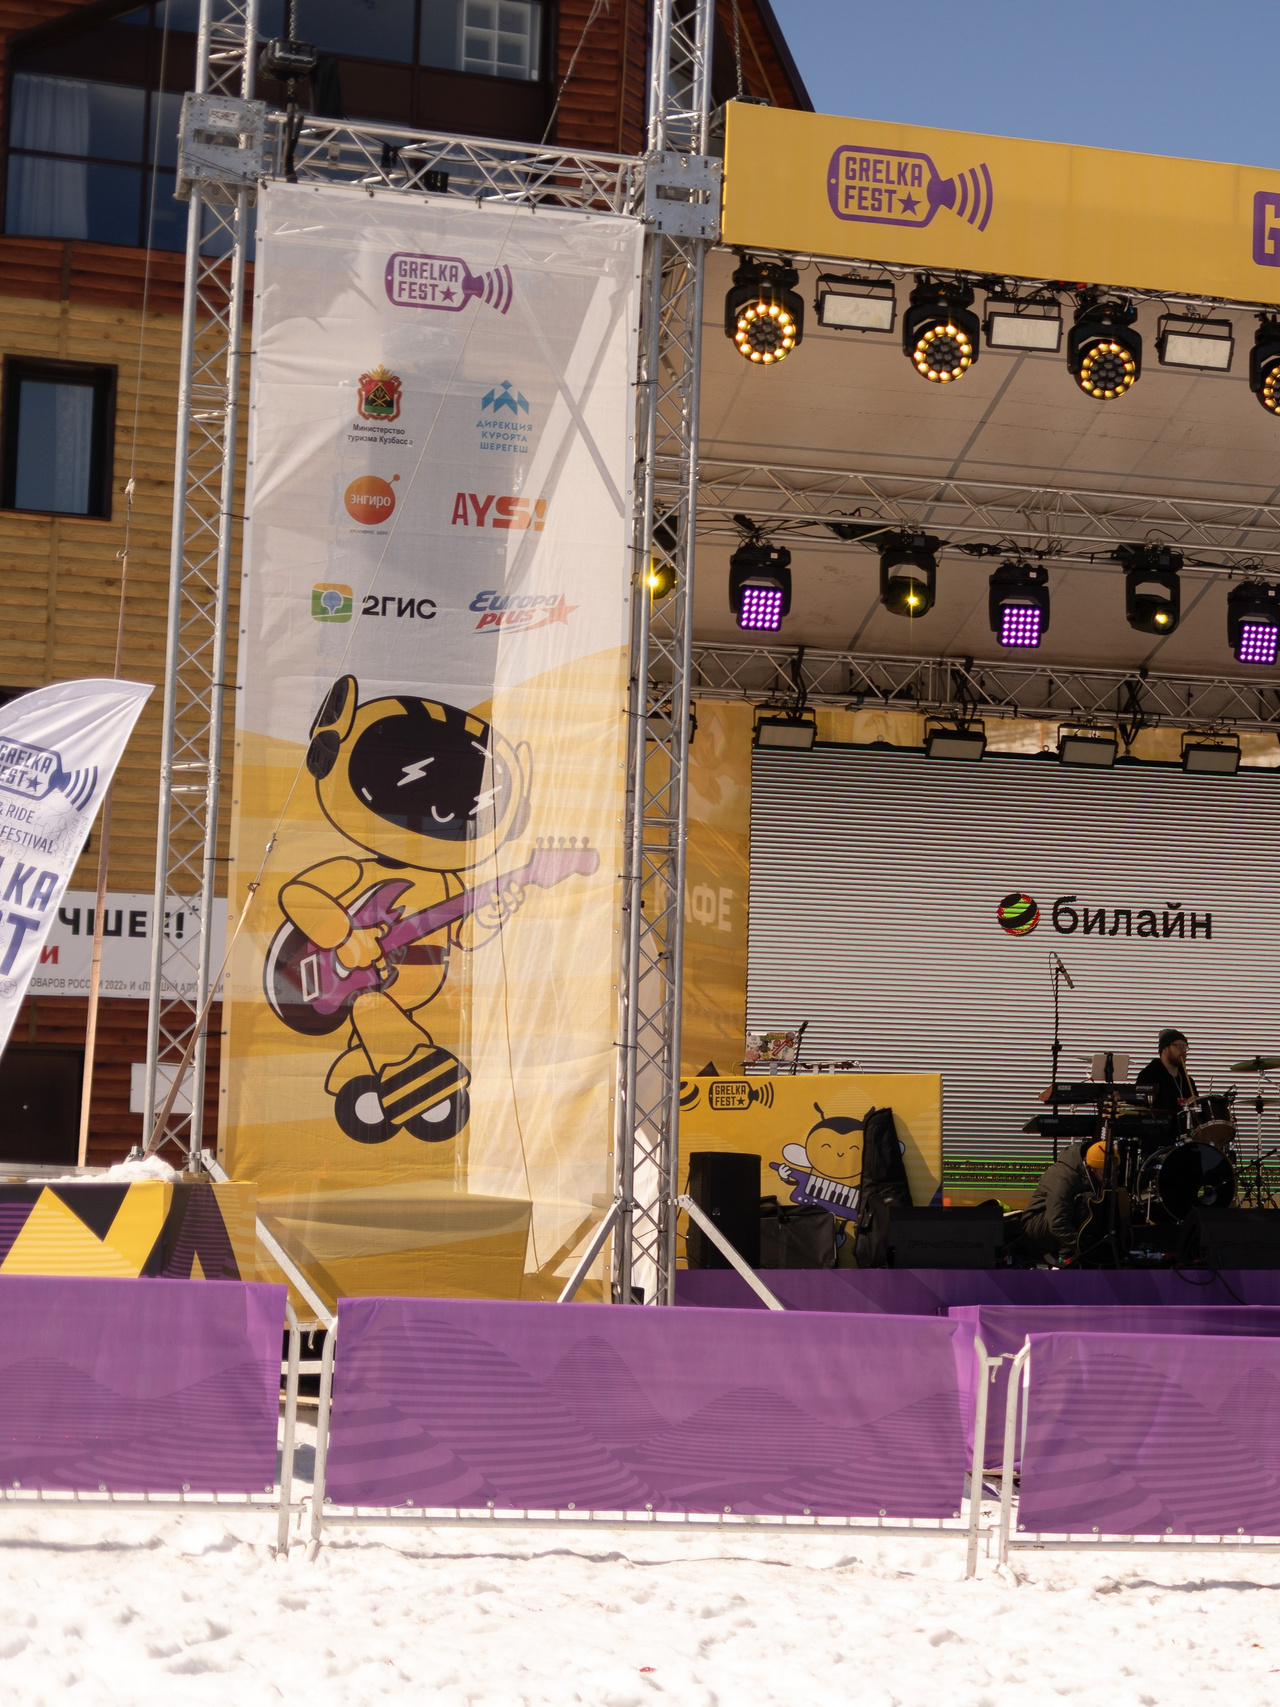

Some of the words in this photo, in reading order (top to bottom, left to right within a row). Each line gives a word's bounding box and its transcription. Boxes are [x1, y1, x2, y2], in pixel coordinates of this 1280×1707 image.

[845, 156, 923, 188] GRELKA
[844, 185, 897, 213] FEST
[399, 260, 459, 283] GRELKA
[398, 281, 439, 301] FEST
[352, 424, 405, 435] Министерство
[476, 420, 533, 432] ДИРЕКЦИЯ
[347, 434, 378, 443] туризма
[379, 435, 414, 445] Кузбасса
[481, 431, 528, 442] КУРОРТА
[479, 442, 528, 453] ШЕРЕГЕШ
[451, 492, 547, 532] AYS!
[362, 595, 437, 619] 2ГИС
[0, 765, 28, 787] EST
[6, 804, 36, 824] RIDE
[1, 826, 54, 854] FESTIVAL
[1052, 895, 1213, 940] билайн
[67, 979, 103, 990] РОССИ
[715, 1085, 747, 1095] GRELKA
[715, 1096, 736, 1107] FEST
